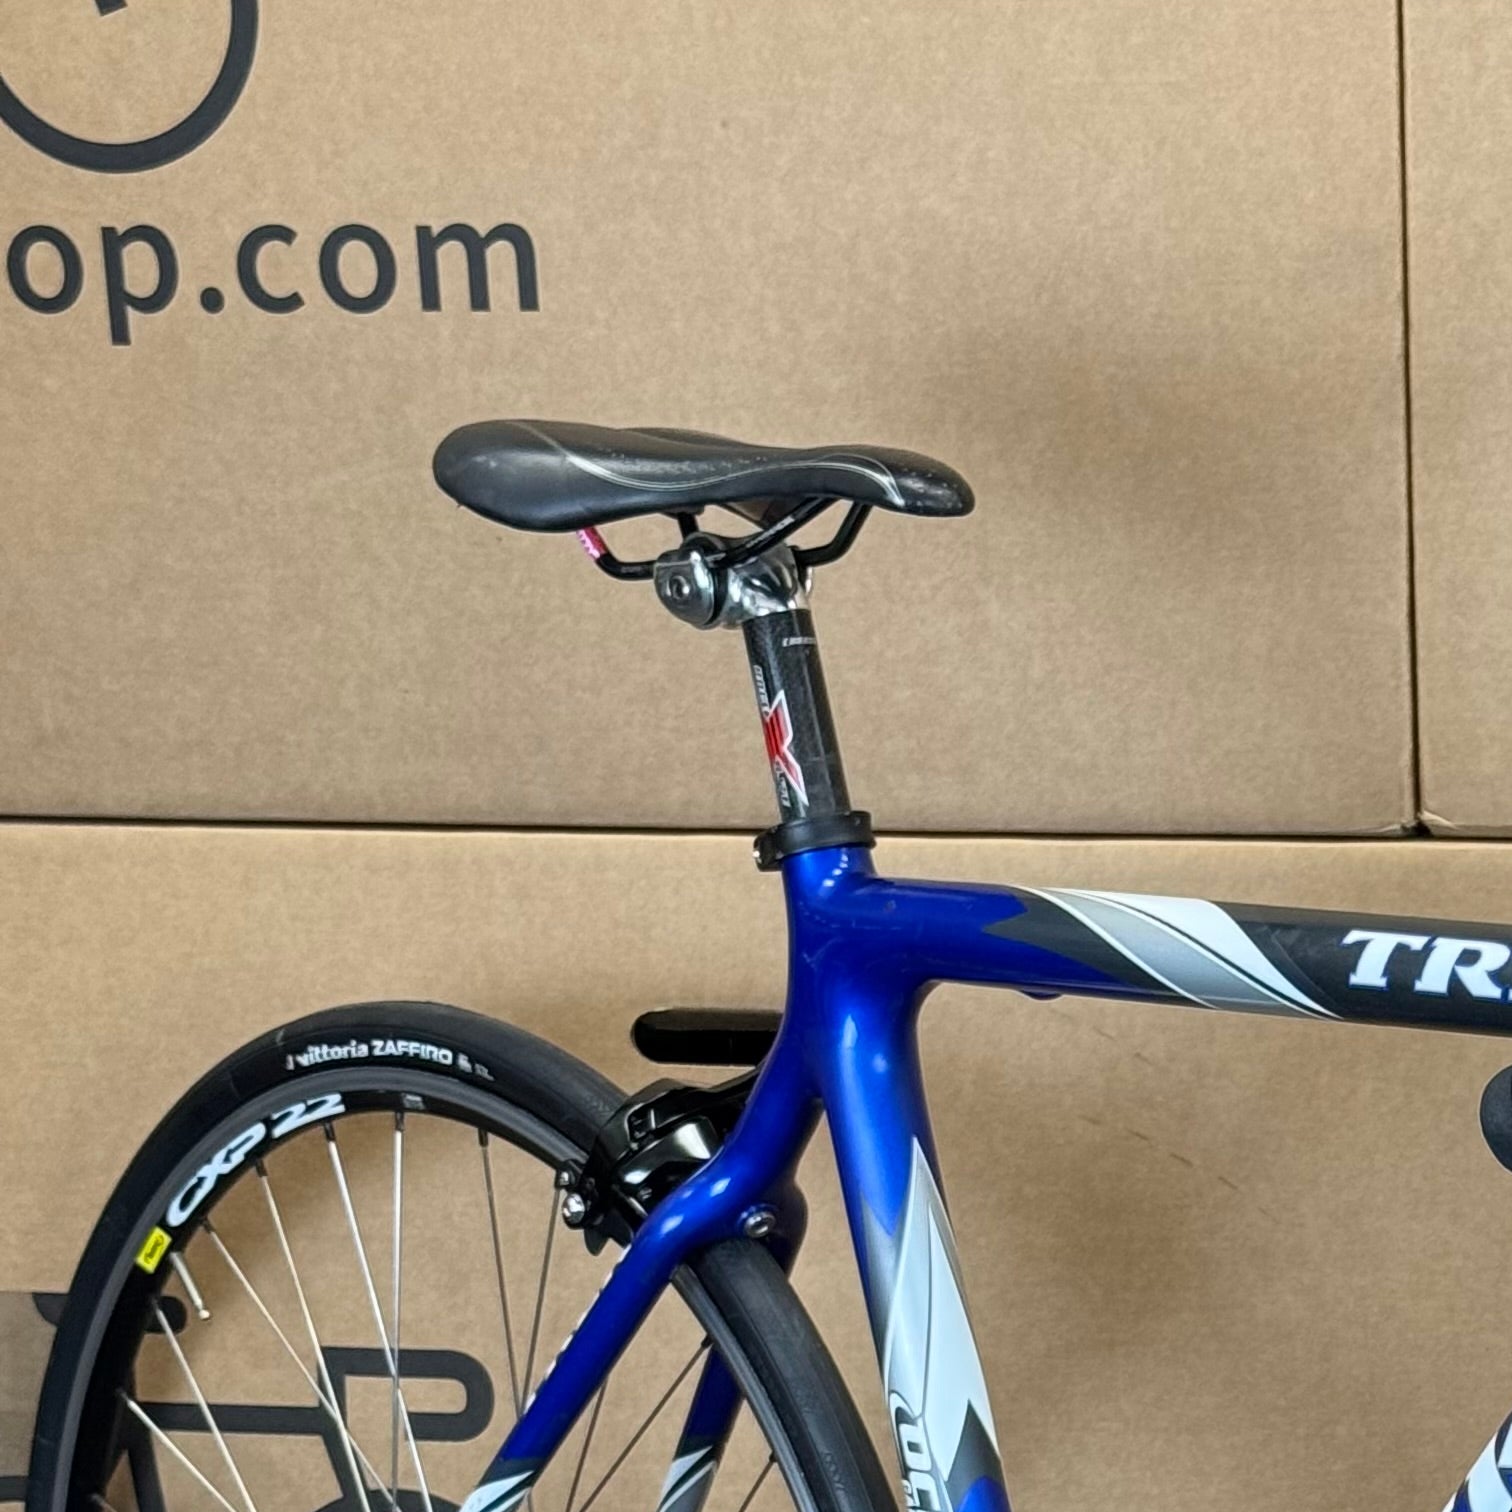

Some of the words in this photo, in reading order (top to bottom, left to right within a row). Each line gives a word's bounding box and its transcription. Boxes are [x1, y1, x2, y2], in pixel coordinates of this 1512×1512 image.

[6, 221, 541, 346] op.com
[295, 1039, 369, 1067] vittoria
[371, 1039, 454, 1067] ZAFFIRO
[166, 1121, 267, 1228] CXP
[271, 1092, 346, 1139] 22
